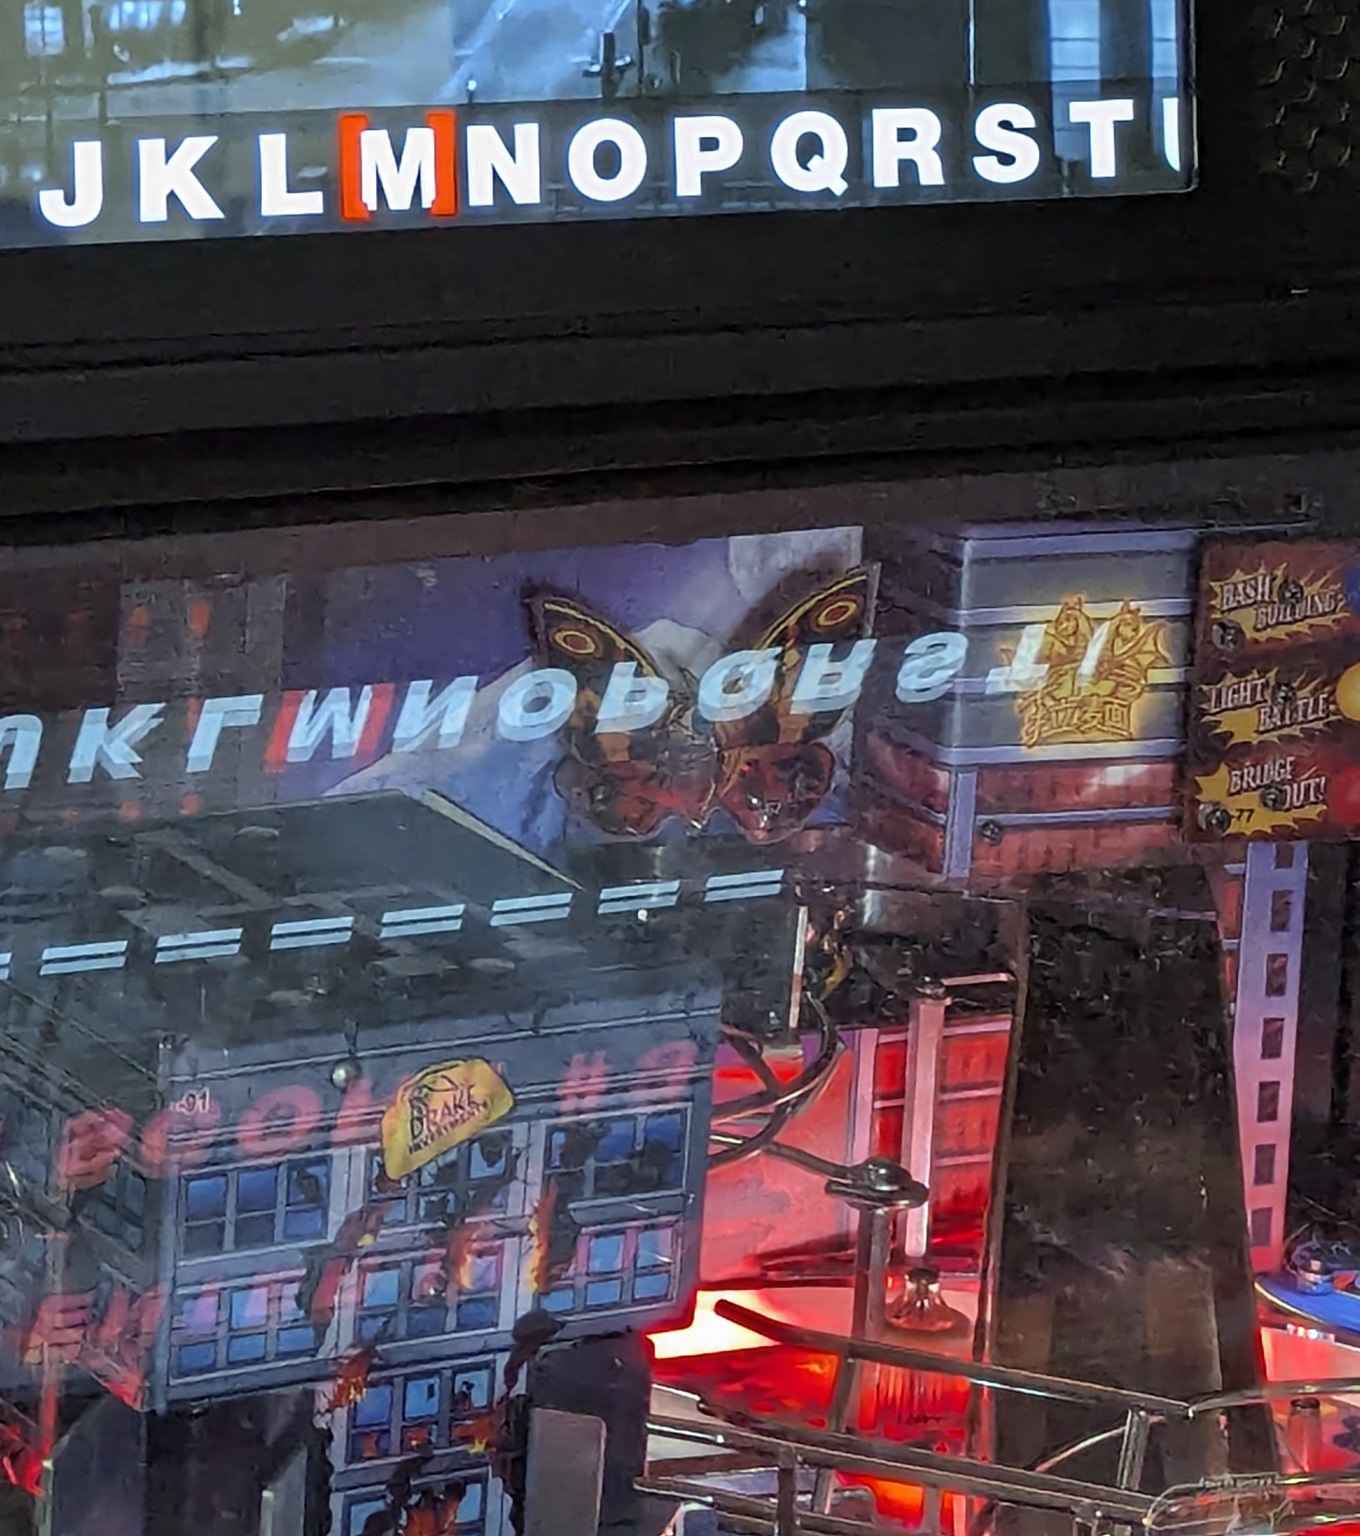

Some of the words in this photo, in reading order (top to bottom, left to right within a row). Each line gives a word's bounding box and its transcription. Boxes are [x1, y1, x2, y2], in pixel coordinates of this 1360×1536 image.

[1222, 575, 1271, 611] BASH
[1210, 678, 1266, 714] LIGHT
[1228, 755, 1296, 795] BRIDGE
